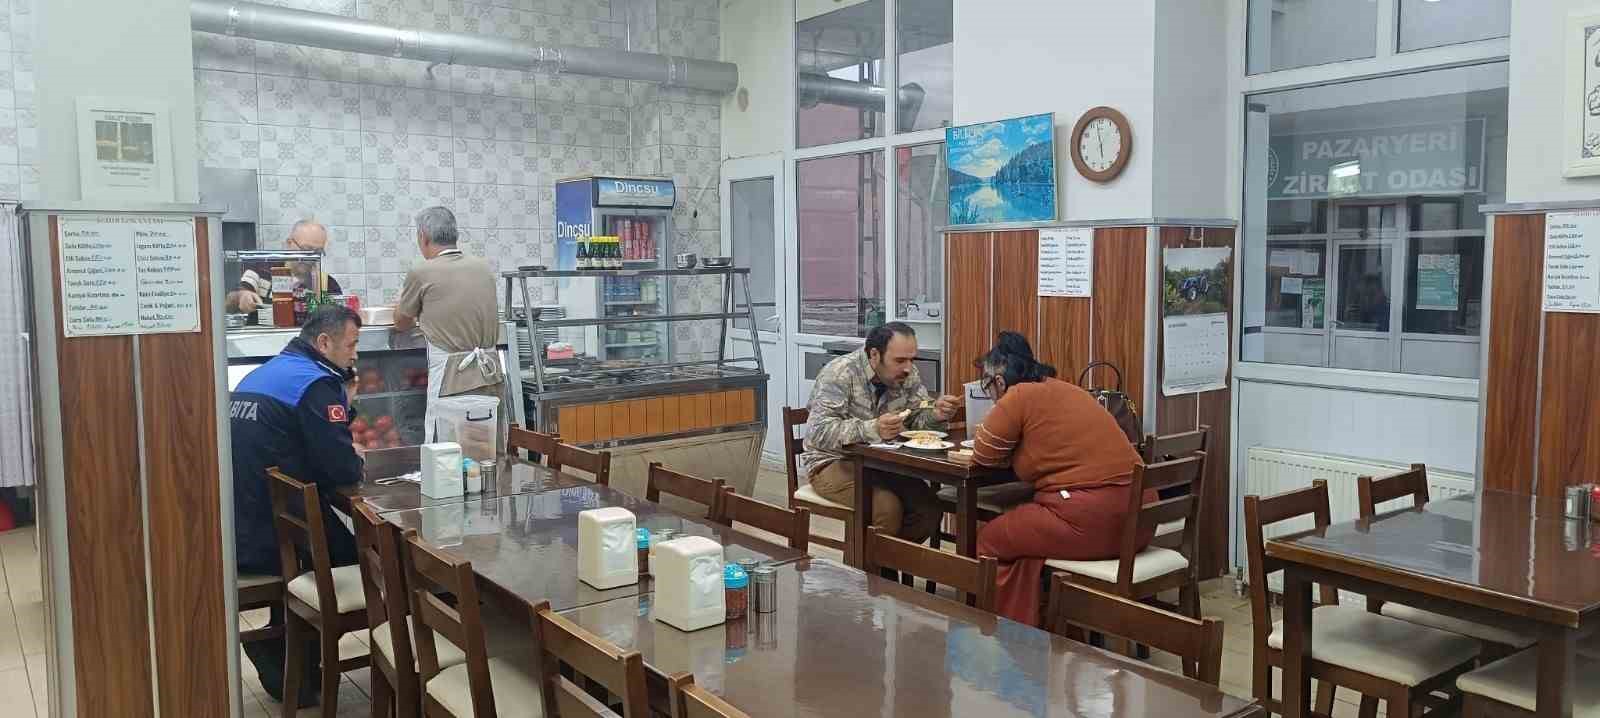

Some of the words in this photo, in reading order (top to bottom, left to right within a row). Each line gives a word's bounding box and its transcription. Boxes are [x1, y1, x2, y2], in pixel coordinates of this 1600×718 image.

[1303, 126, 1457, 160] PAZARYERİ
[1387, 166, 1479, 190] ODASI
[230, 400, 257, 420] BITA
